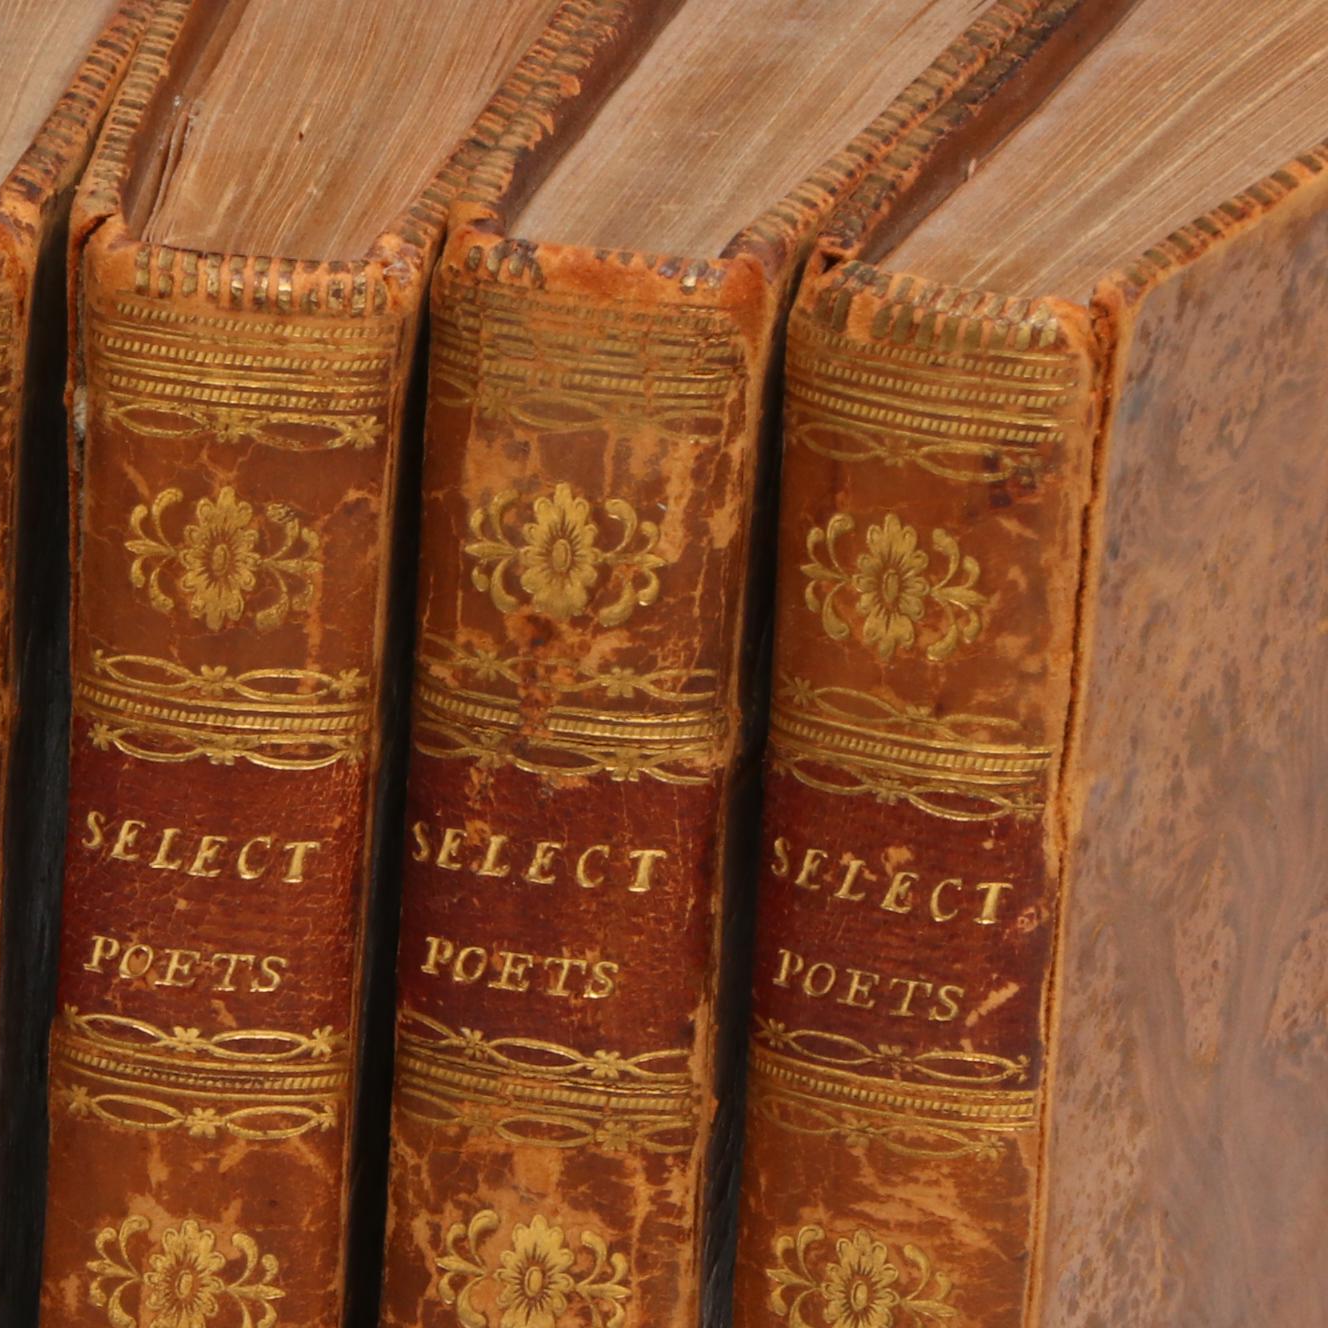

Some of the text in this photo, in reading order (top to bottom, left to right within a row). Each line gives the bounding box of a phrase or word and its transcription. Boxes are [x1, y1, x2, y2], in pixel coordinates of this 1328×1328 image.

[81, 811, 320, 883] SELECT
[411, 822, 667, 893] SELECT
[771, 836, 1014, 925] SELECT
[83, 934, 289, 993] POETS
[420, 936, 620, 1000] POETS
[771, 948, 965, 1022] POETS
